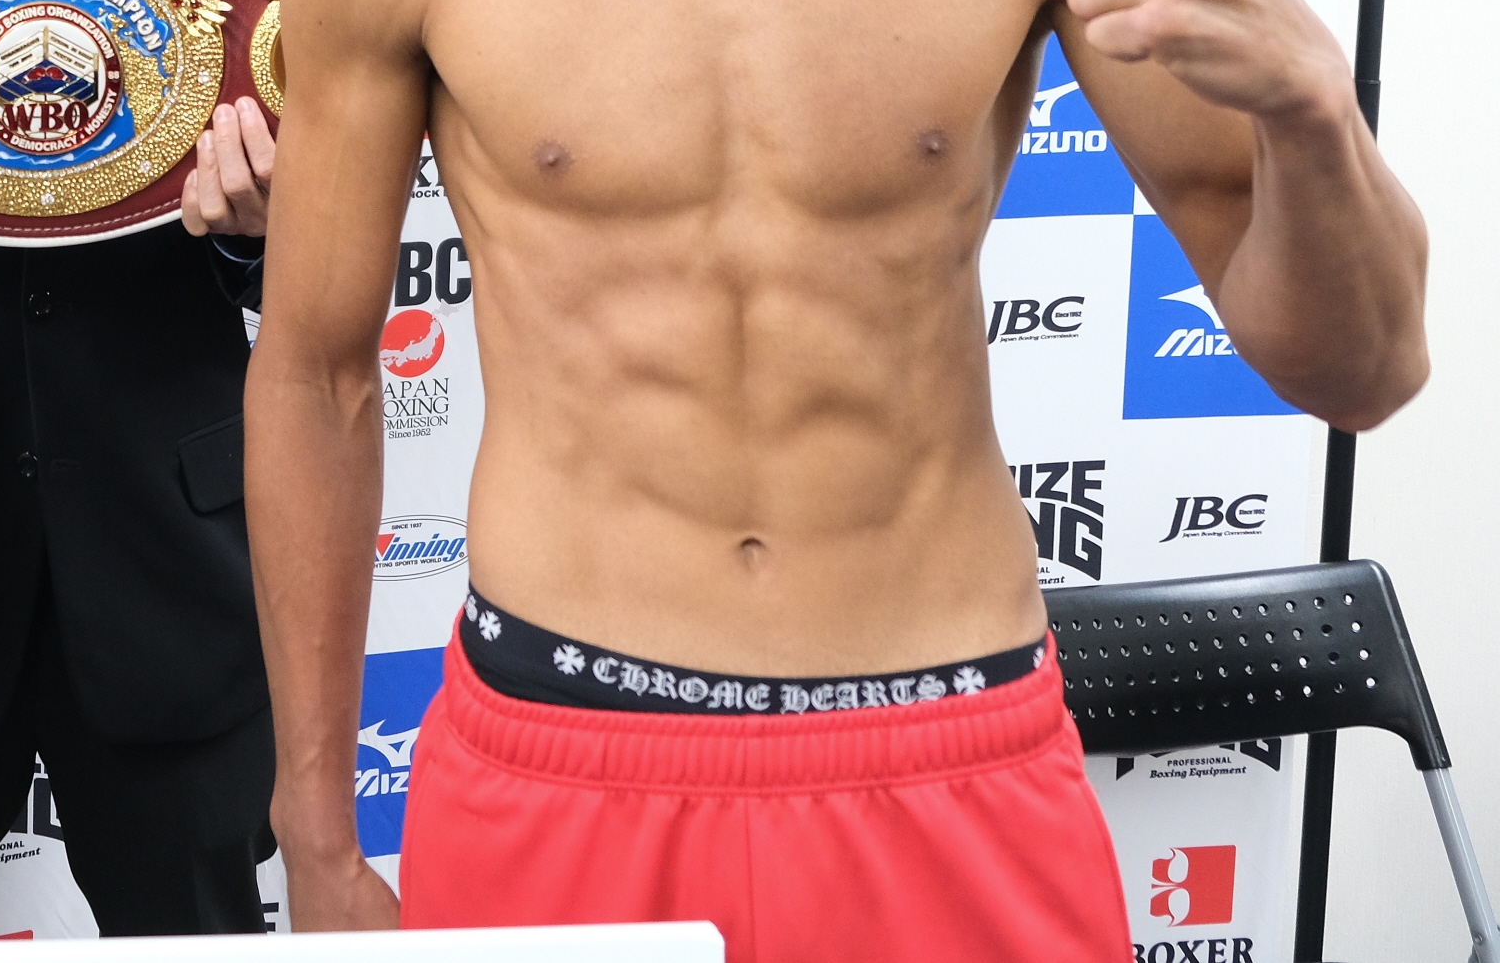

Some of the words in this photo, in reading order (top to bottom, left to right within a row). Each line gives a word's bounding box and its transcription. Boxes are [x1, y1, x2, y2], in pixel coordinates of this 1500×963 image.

[4, 6, 46, 29] BOXING
[46, 5, 115, 59] ORGANIZATION
[3, 102, 90, 131] WBO
[10, 135, 78, 152] DEMOCRACY
[84, 87, 118, 134] HONESTY
[1017, 130, 1108, 155] IZUNO
[394, 237, 473, 307] BC
[988, 296, 1085, 345] JBC
[1154, 328, 1238, 357] MIZ
[383, 377, 449, 399] APAN
[382, 397, 449, 419] OXING
[382, 415, 449, 431] OMMISSION
[1009, 459, 1106, 518] IZE
[1158, 493, 1269, 544] JBC
[591, 655, 773, 712] CHROME
[778, 672, 949, 715] HEARTS
[1149, 769, 1187, 779] Boxing
[1188, 765, 1247, 779] Equipment
[1167, 756, 1233, 767] PROFESSIONAL
